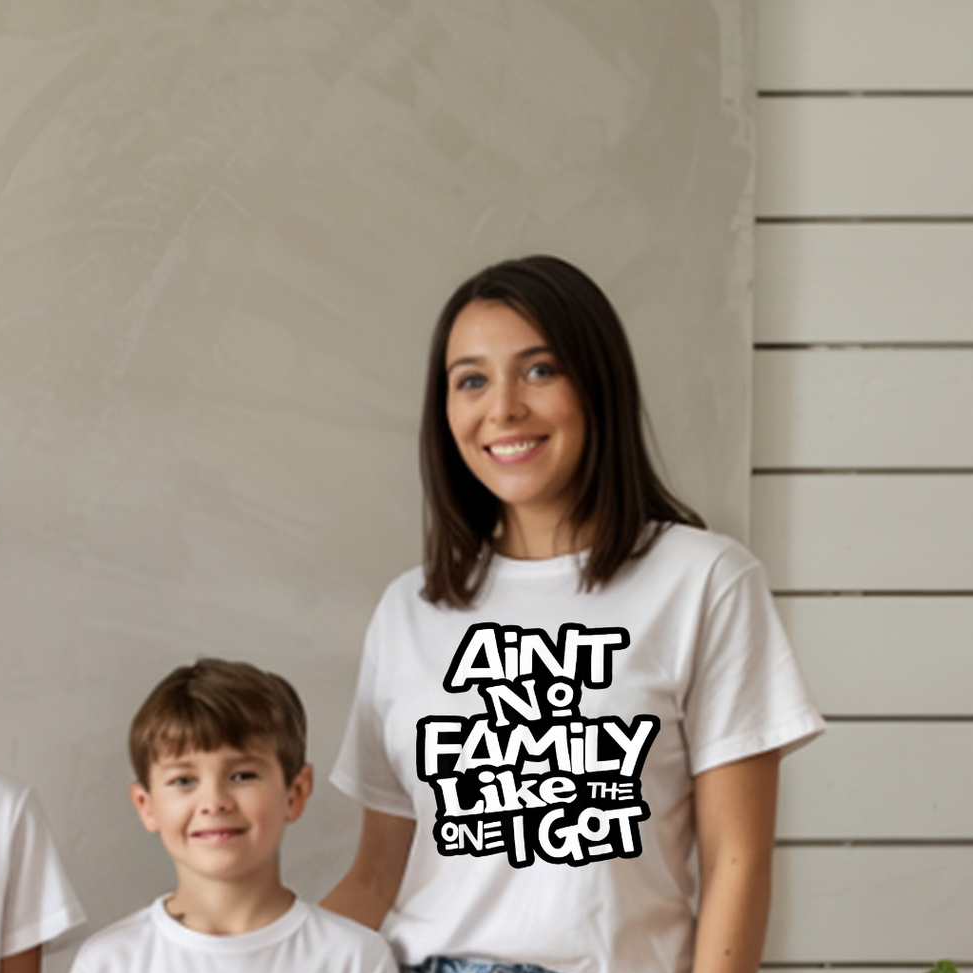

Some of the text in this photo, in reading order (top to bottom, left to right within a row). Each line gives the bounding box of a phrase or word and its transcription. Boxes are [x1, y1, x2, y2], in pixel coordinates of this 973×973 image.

[435, 769, 635, 818] Like THE
[439, 819, 506, 851] ONE
[537, 804, 644, 861] GOT
